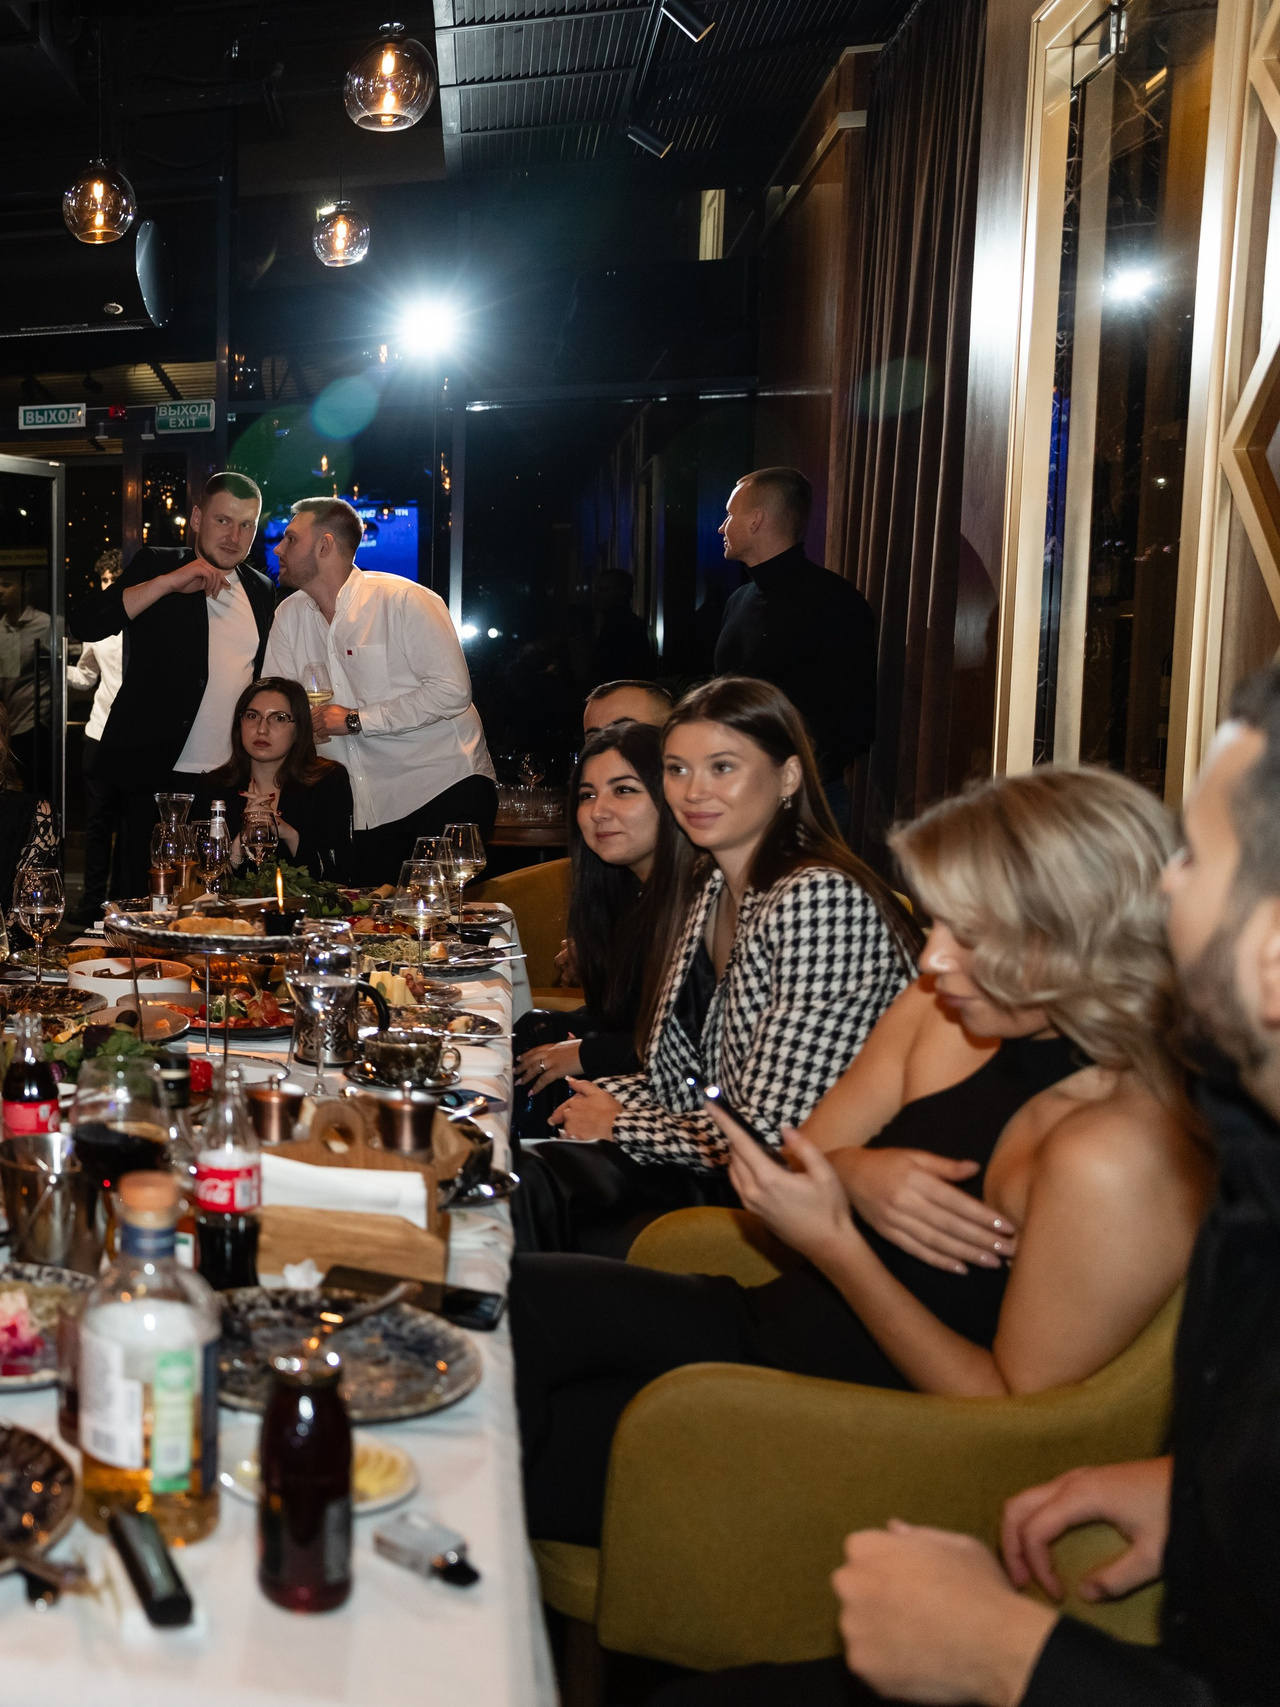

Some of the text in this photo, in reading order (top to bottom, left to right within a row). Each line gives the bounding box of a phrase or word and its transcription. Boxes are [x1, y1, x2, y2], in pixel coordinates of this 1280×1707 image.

[25, 408, 79, 424] ВЫХОД
[158, 404, 208, 416] ВЫХОД
[169, 416, 197, 428] EXIT
